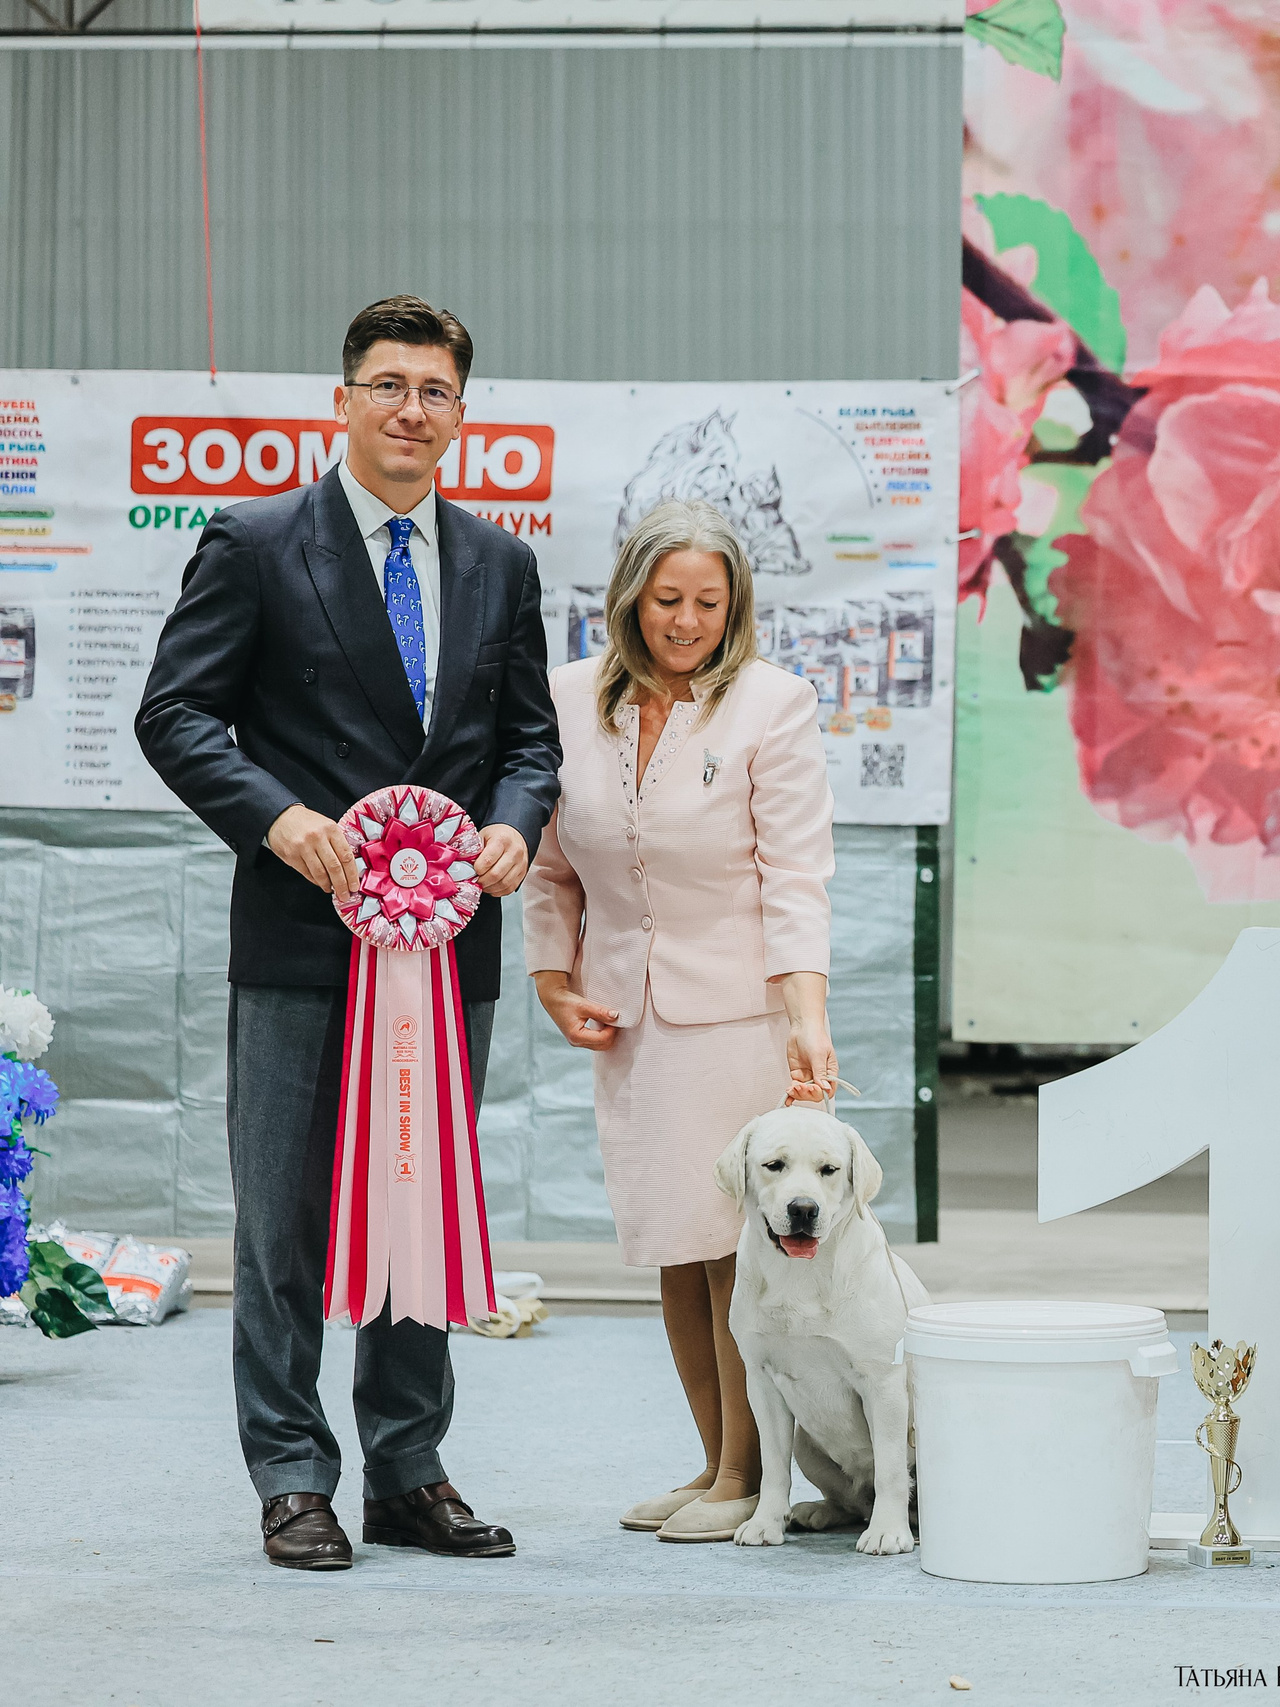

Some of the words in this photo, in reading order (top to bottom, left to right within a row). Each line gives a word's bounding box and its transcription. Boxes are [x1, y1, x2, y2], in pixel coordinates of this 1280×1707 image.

[400, 1068, 411, 1098] BEST
[400, 1101, 411, 1113] IN
[400, 1116, 411, 1152] SHOW
[400, 1162, 411, 1174] 1
